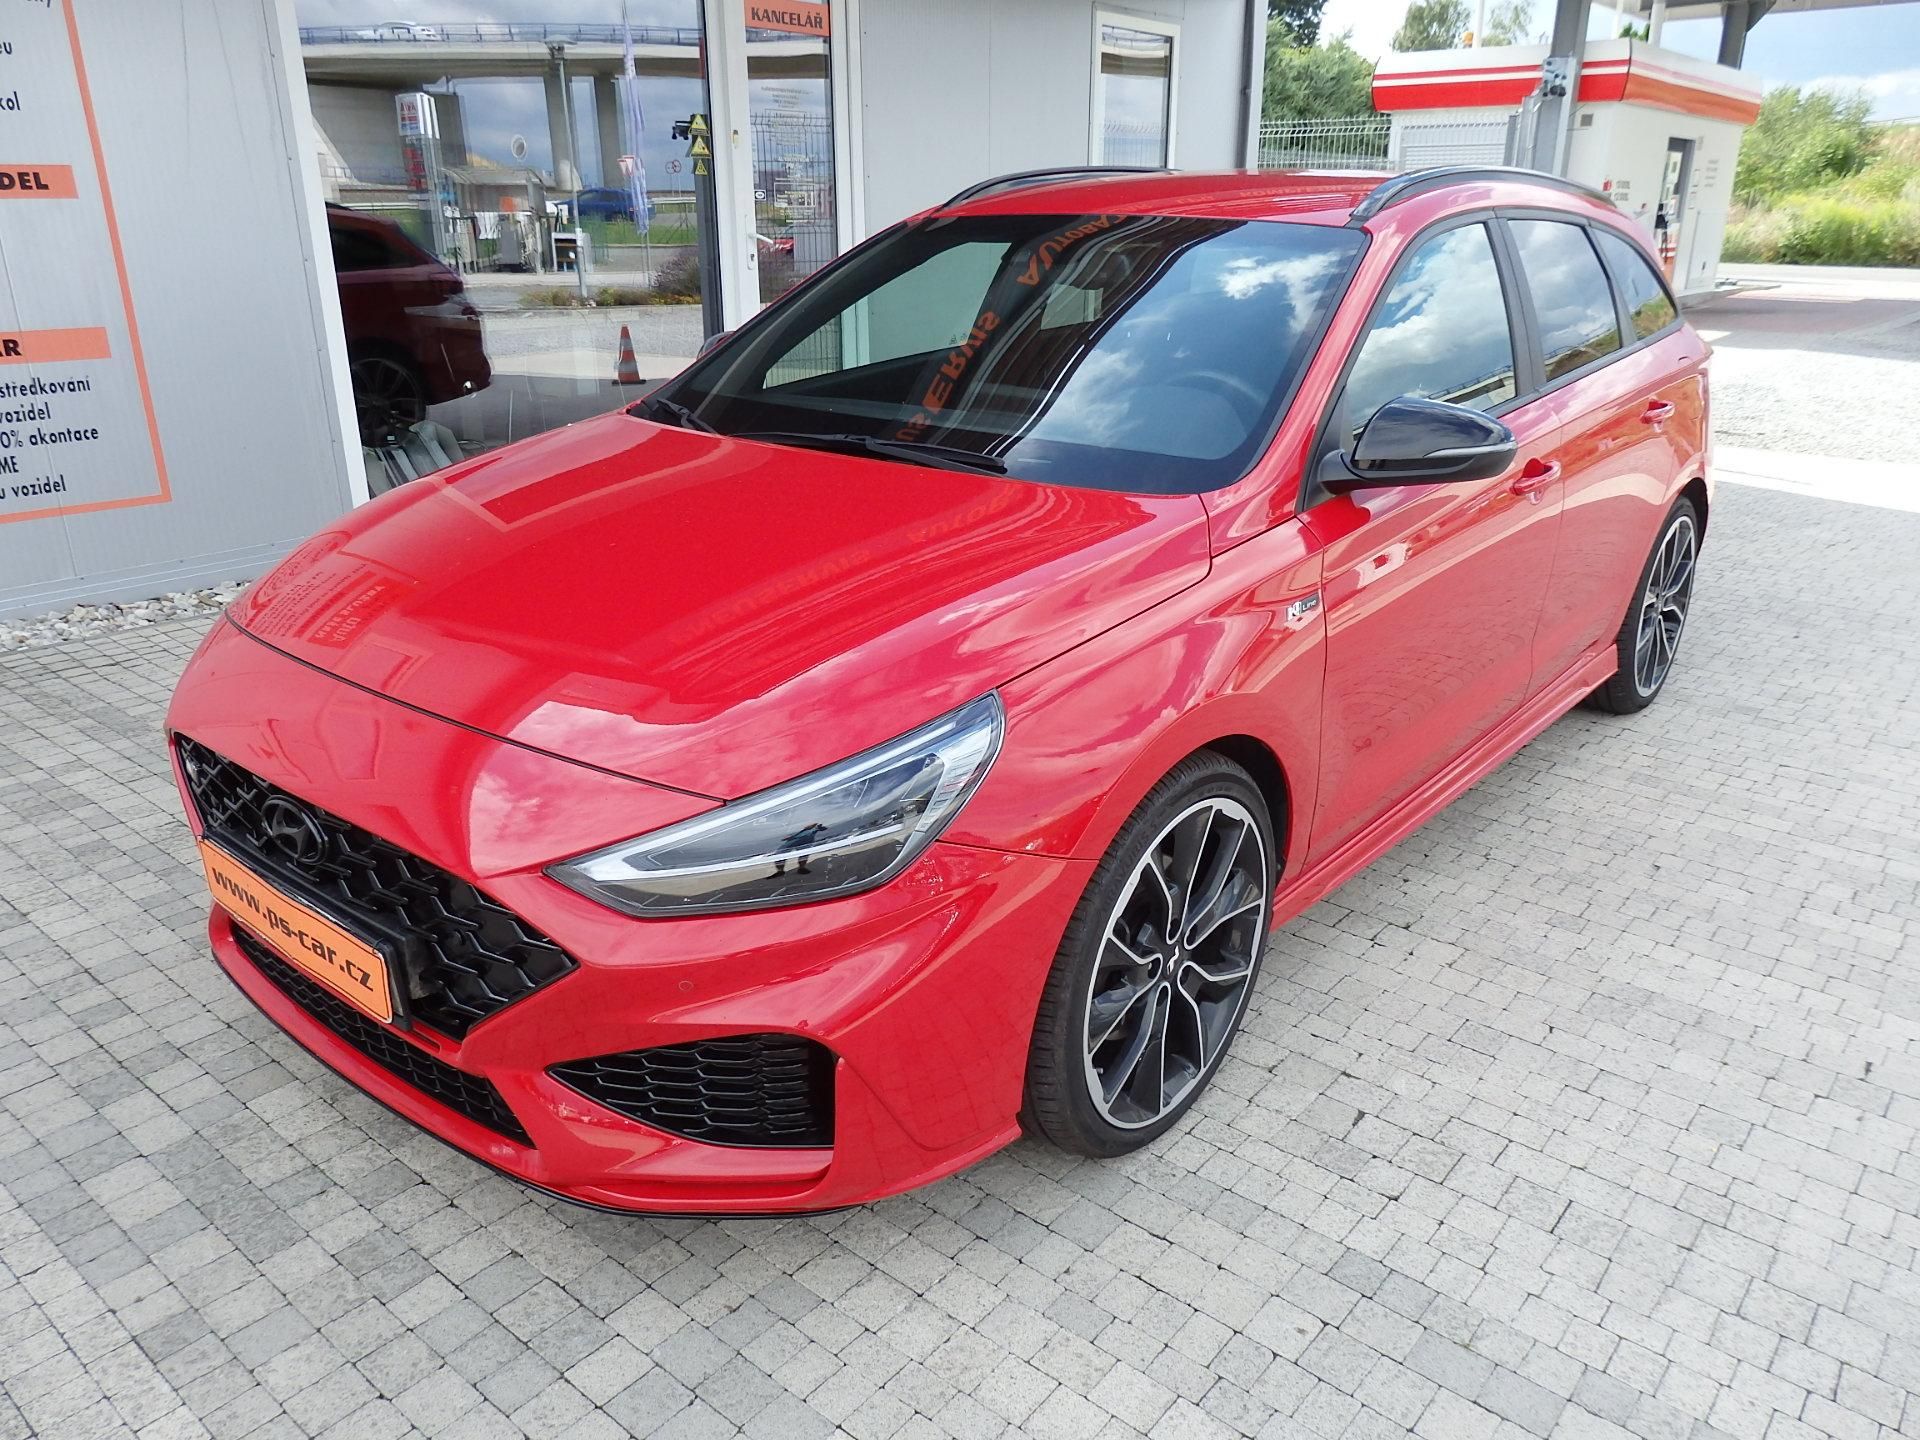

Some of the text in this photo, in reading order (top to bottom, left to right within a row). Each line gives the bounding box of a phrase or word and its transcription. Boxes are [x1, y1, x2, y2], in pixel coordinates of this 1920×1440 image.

[751, 7, 823, 29] KANCELÁŘ
[0, 339, 22, 357] R
[29, 427, 99, 446] akontace
[11, 474, 67, 498] vozidel
[211, 867, 374, 992] www.ps-car.cz
